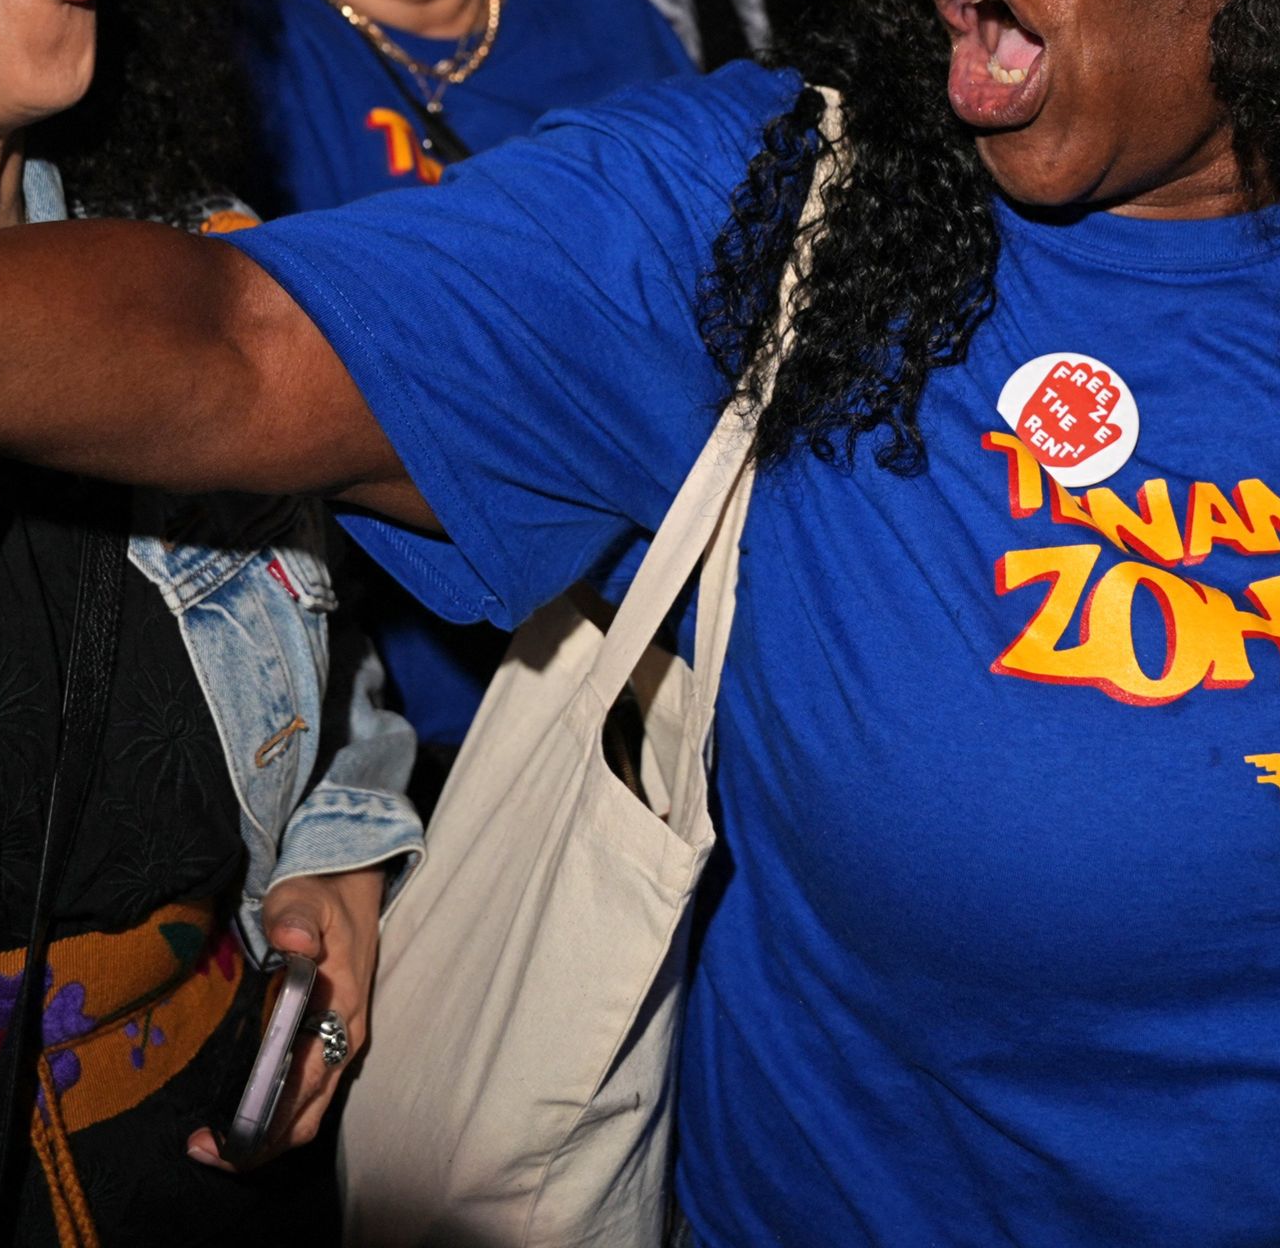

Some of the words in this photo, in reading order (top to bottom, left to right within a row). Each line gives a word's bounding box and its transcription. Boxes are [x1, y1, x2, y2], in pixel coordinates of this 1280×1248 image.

[1041, 387, 1078, 432] THE
[1053, 365, 1114, 444] FREEZE
[1023, 414, 1086, 459] RENT!
